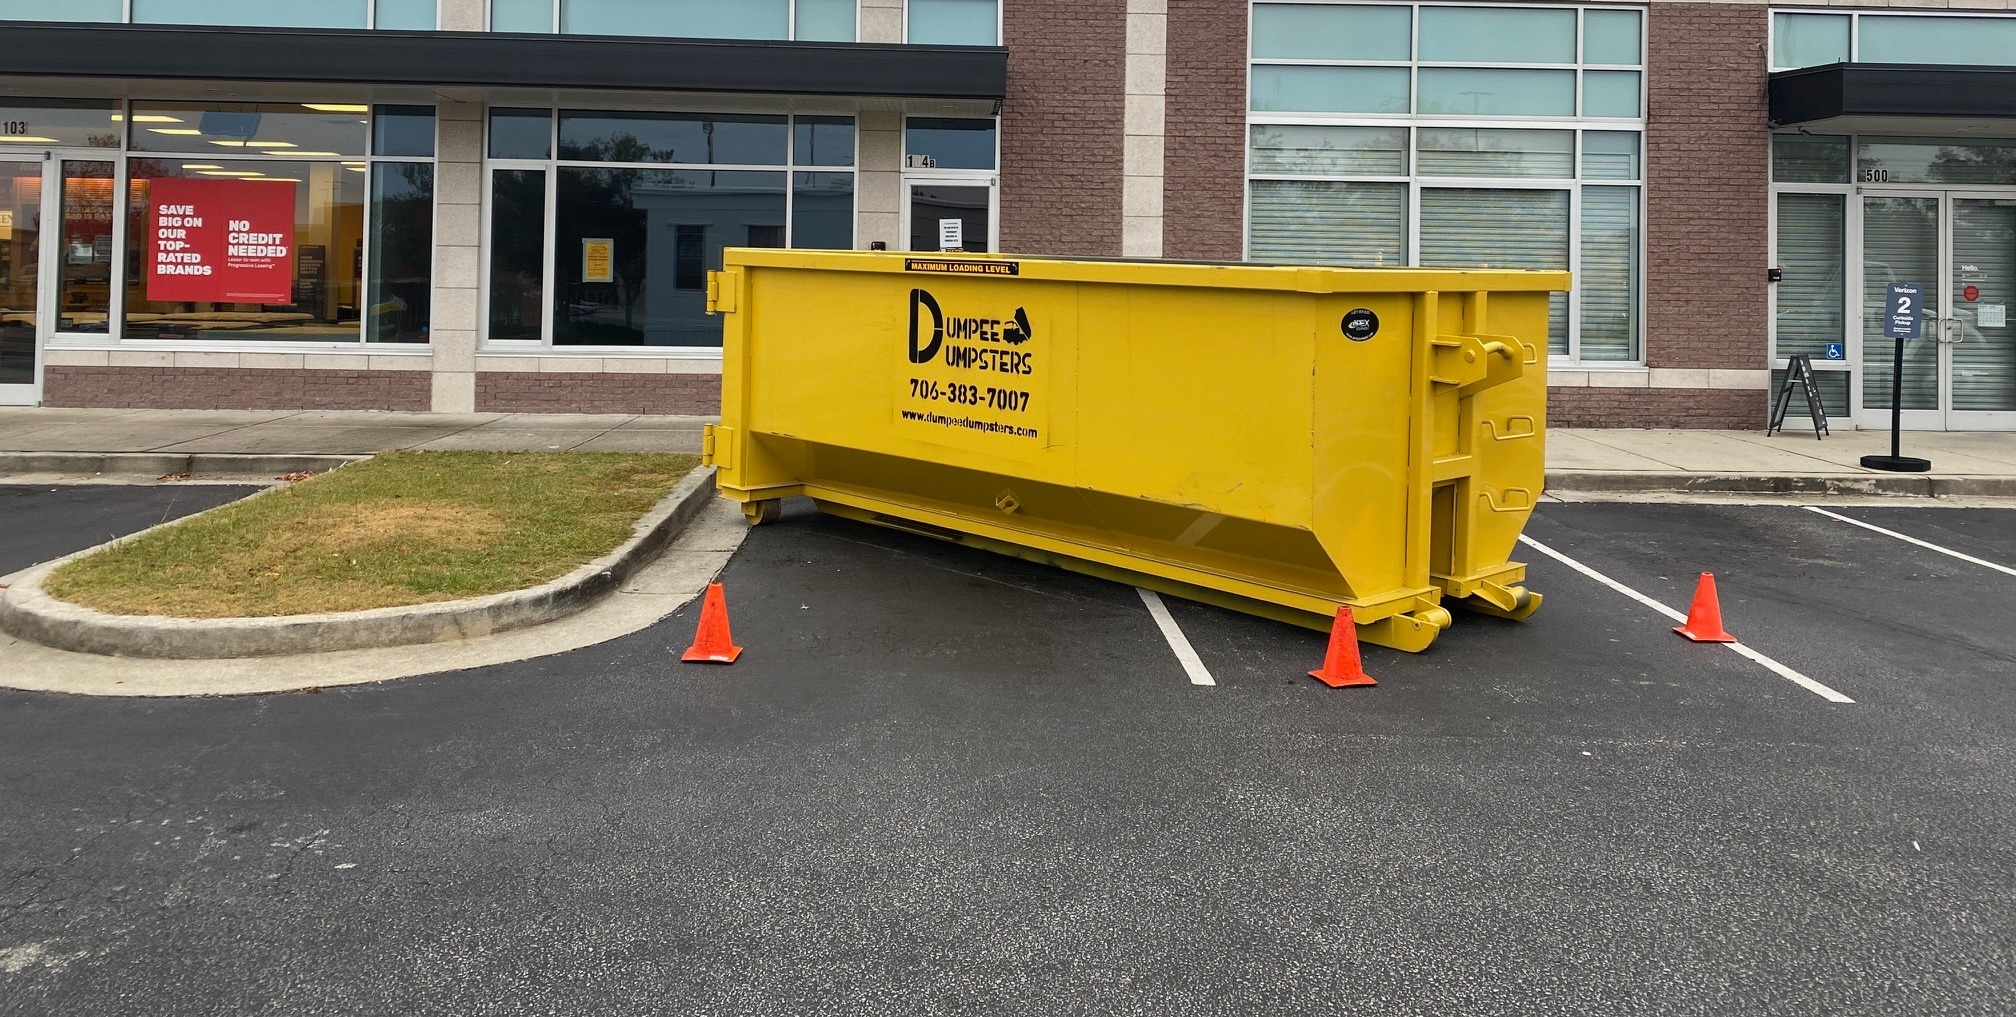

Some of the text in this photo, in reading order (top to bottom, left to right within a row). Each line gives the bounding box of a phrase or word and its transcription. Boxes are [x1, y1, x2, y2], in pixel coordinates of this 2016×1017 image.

[3, 121, 26, 135] 103
[1866, 169, 1888, 182] 500
[158, 205, 194, 215] SAVE
[158, 216, 203, 228] BIG ON
[228, 220, 250, 232] NO
[158, 228, 187, 239] OUR
[228, 233, 283, 245] CREDIT
[157, 240, 191, 251] TOP-
[157, 252, 201, 263] RATED
[156, 264, 212, 276] BRANDS
[911, 262, 1011, 274] MAXIMUM LOADING LEVEL
[1894, 286, 1917, 294] Verizon
[1897, 296, 1911, 314] 2
[909, 378, 1030, 412] 706-383-7007
[901, 409, 1038, 438] www.dumpeedumpsters.com
